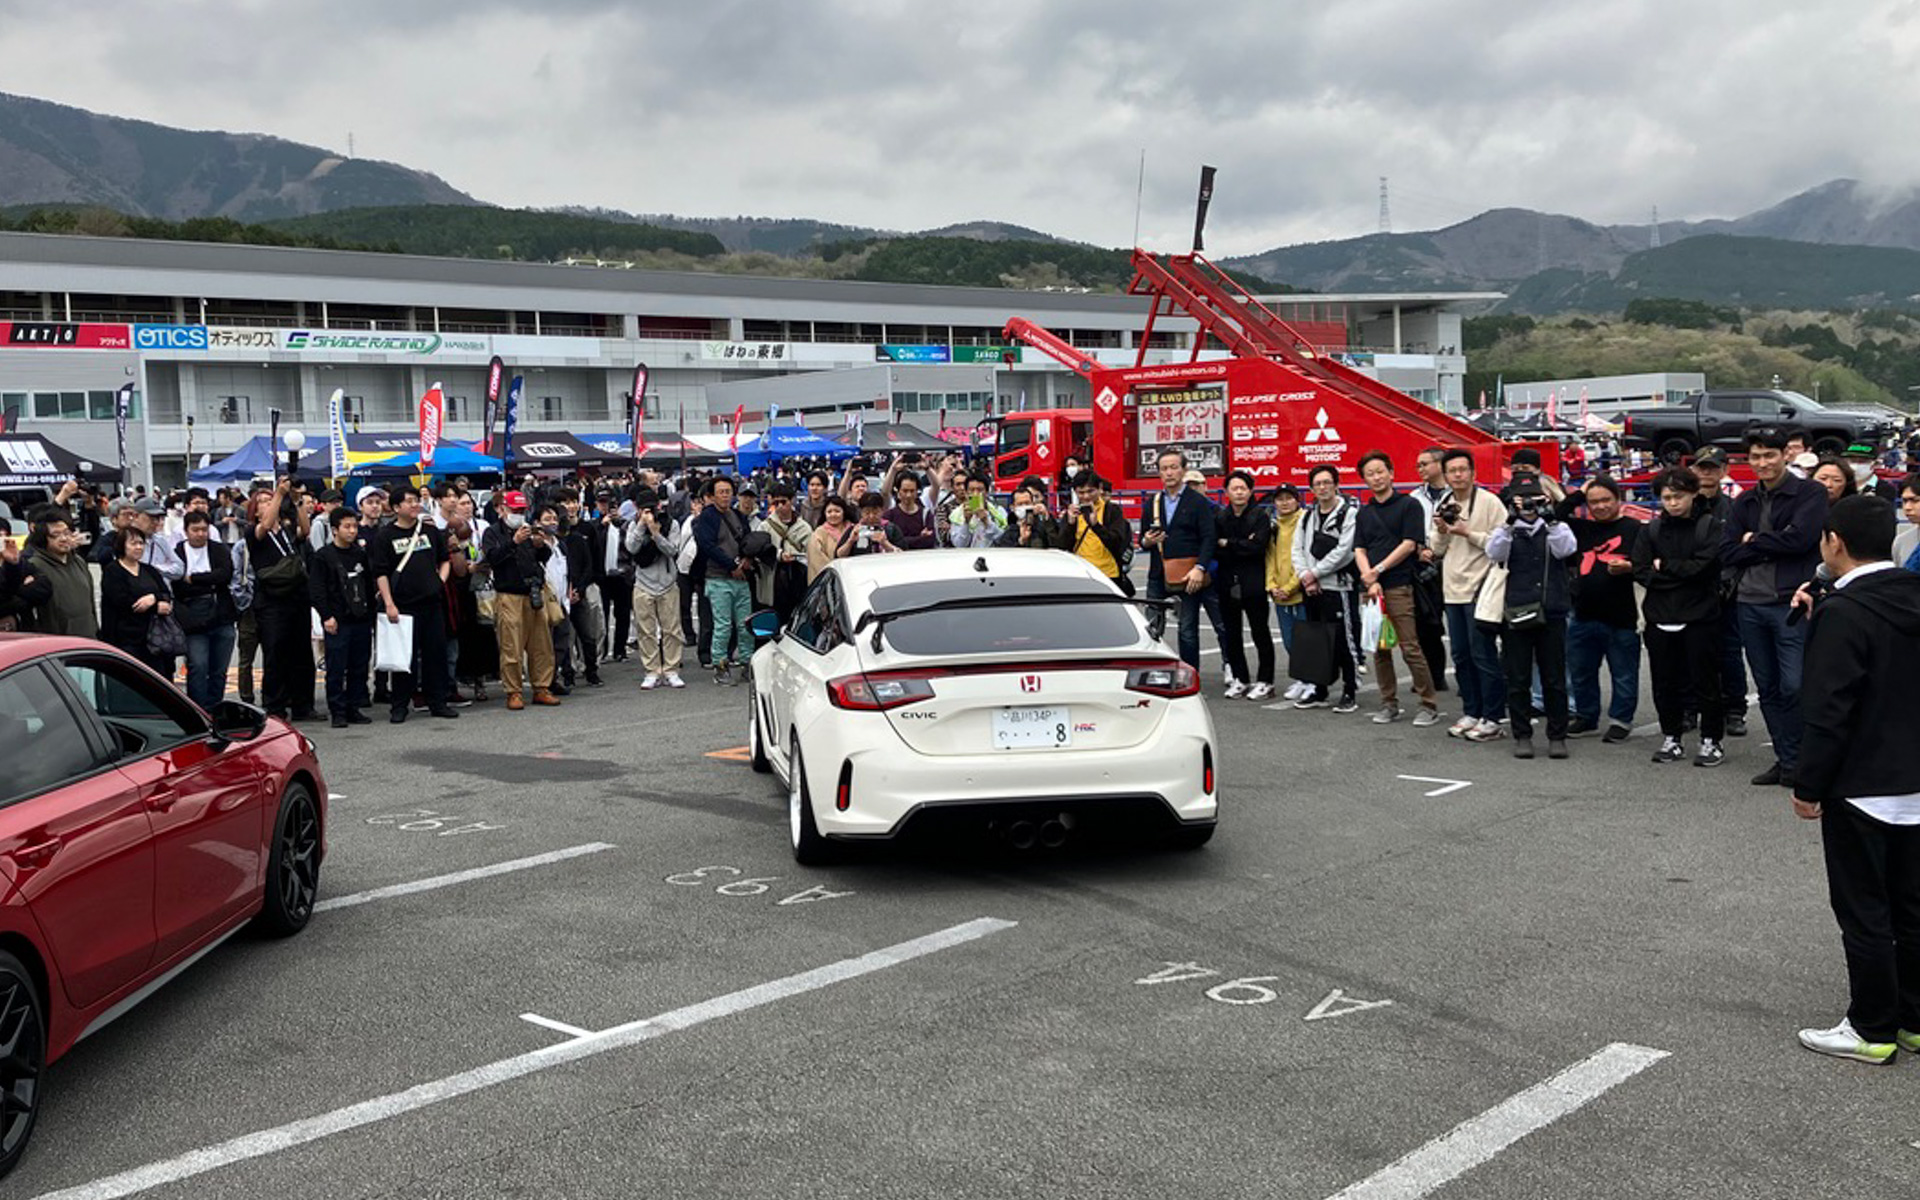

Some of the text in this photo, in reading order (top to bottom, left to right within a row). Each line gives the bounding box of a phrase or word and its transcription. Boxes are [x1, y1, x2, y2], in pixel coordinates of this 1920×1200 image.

[137, 327, 206, 348] OTICS
[209, 331, 277, 348] オティックス
[311, 335, 427, 350] SHADE RACING
[723, 343, 785, 360] ばねの東郷
[489, 362, 501, 396] TONE
[1232, 391, 1317, 405] ECLIPSE CROSS
[1141, 403, 1221, 424] 体験イベント
[526, 446, 571, 455] TONE
[1298, 443, 1347, 454] MITSUBISHI
[7, 457, 51, 468] ksp
[1304, 453, 1342, 463] MOTORS
[901, 711, 938, 719] CIVIC
[1074, 722, 1097, 733] HRC
[664, 864, 856, 906] A93
[1133, 960, 1393, 1021] A94
